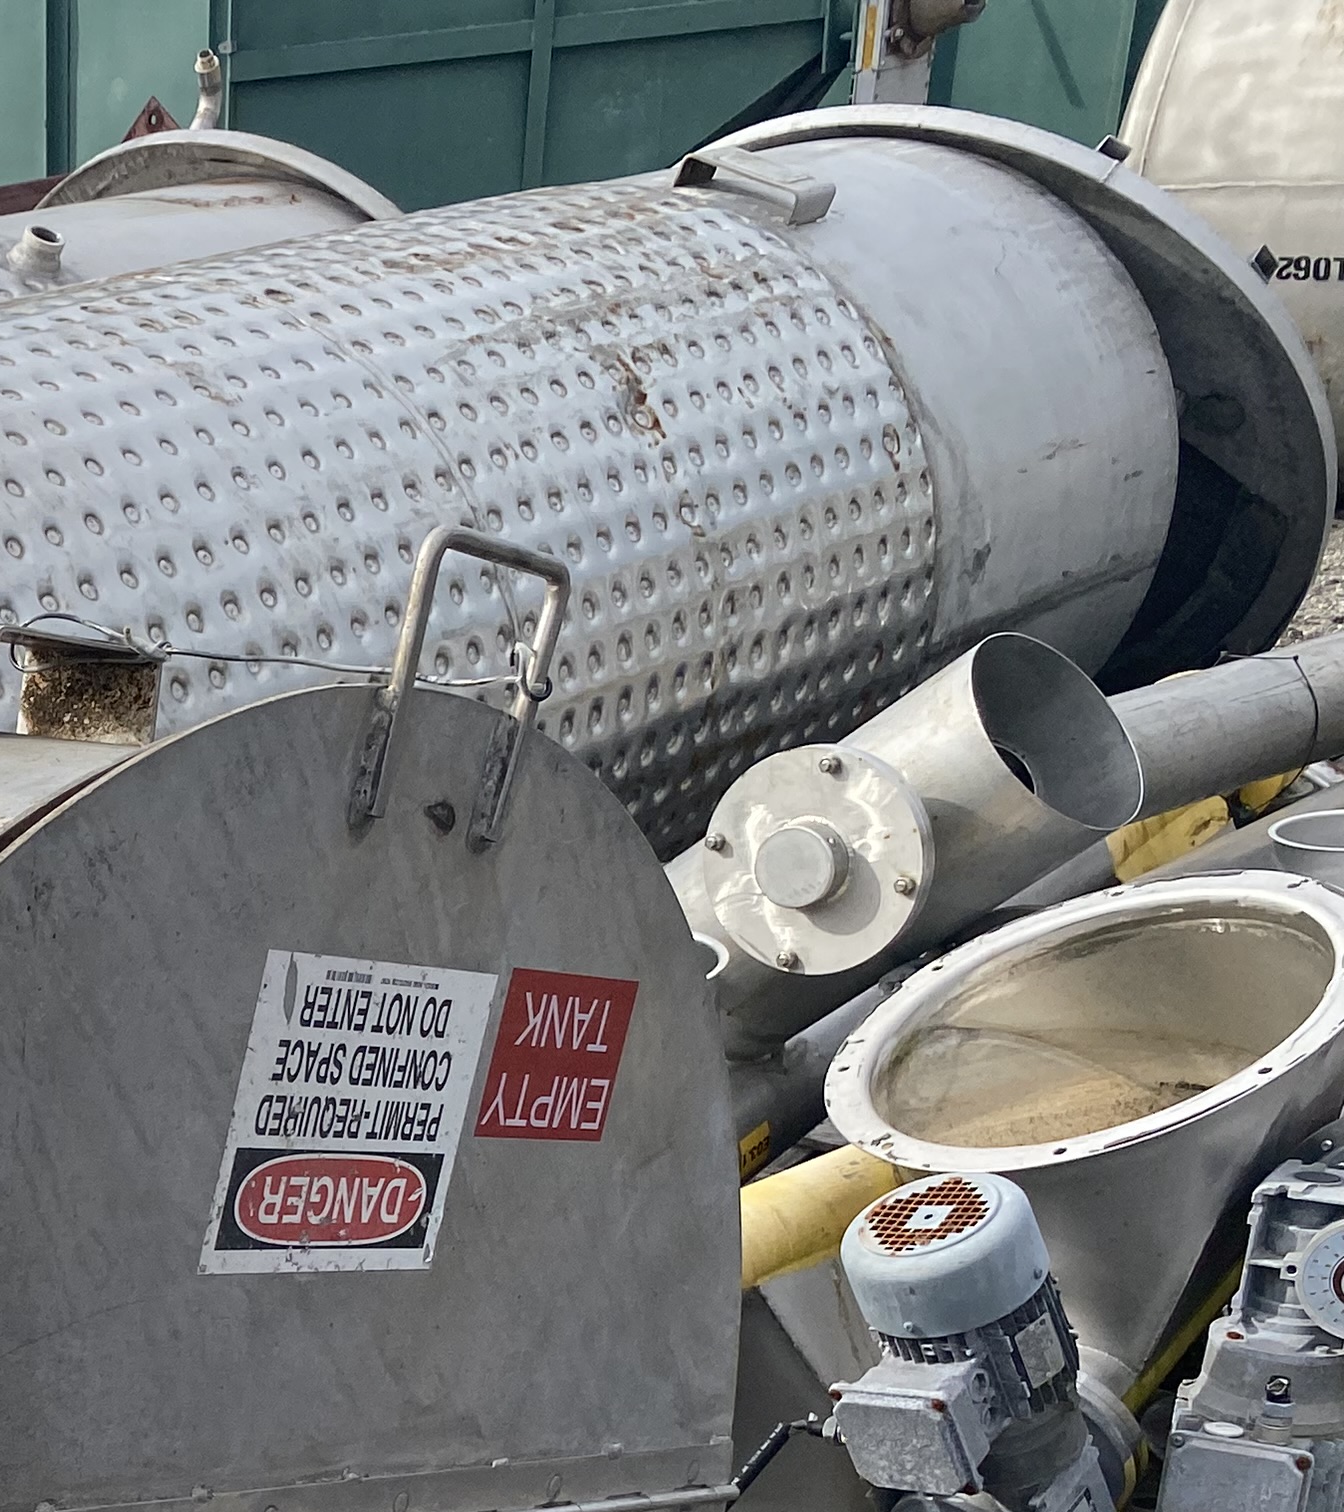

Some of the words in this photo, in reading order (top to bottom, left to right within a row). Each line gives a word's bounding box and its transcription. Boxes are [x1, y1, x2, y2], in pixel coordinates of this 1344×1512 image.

[299, 985, 372, 1032] ENTER
[370, 992, 419, 1036] NOT
[419, 996, 452, 1038] DO
[513, 991, 611, 1053] TANK
[271, 1039, 347, 1085] SPACE
[348, 1045, 452, 1092] CONFINED
[255, 1094, 444, 1142] PERMIT-REQUIRED
[480, 1072, 611, 1130] EMPTY
[258, 1175, 407, 1224] DANGER
